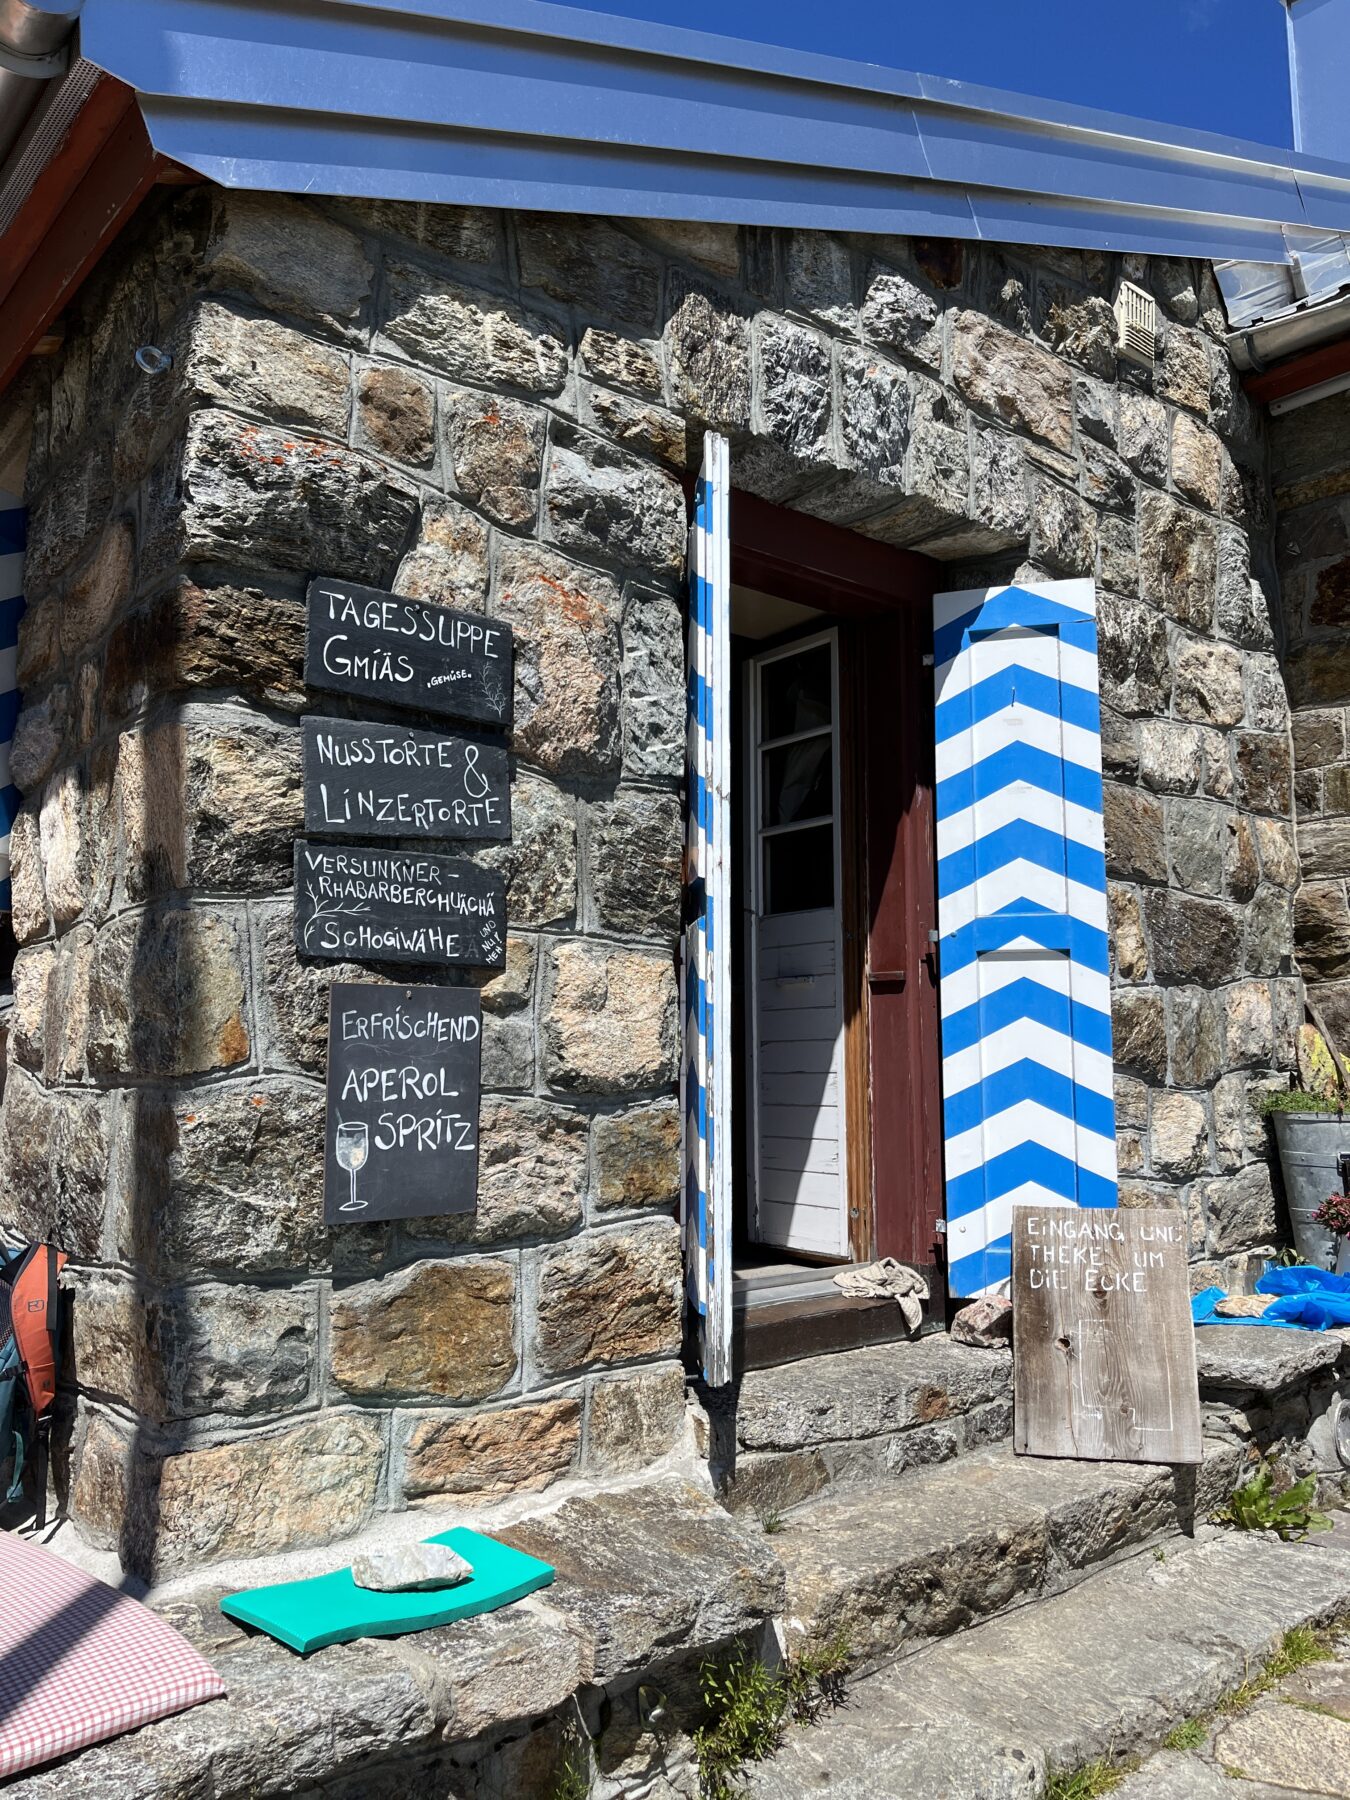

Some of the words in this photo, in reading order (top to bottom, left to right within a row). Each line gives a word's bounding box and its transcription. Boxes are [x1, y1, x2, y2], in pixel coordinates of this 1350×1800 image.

[319, 590, 501, 658] TAGESSUPPE
[316, 734, 453, 768] NUSSTORTE
[463, 745, 492, 798] &
[305, 851, 442, 885] VERSUNKNER
[480, 920, 496, 938] UND
[341, 1066, 459, 1103] APEROL
[1030, 1245, 1104, 1266] THEKE
[1134, 1251, 1164, 1268] UM
[1085, 1269, 1147, 1293] ECKE
